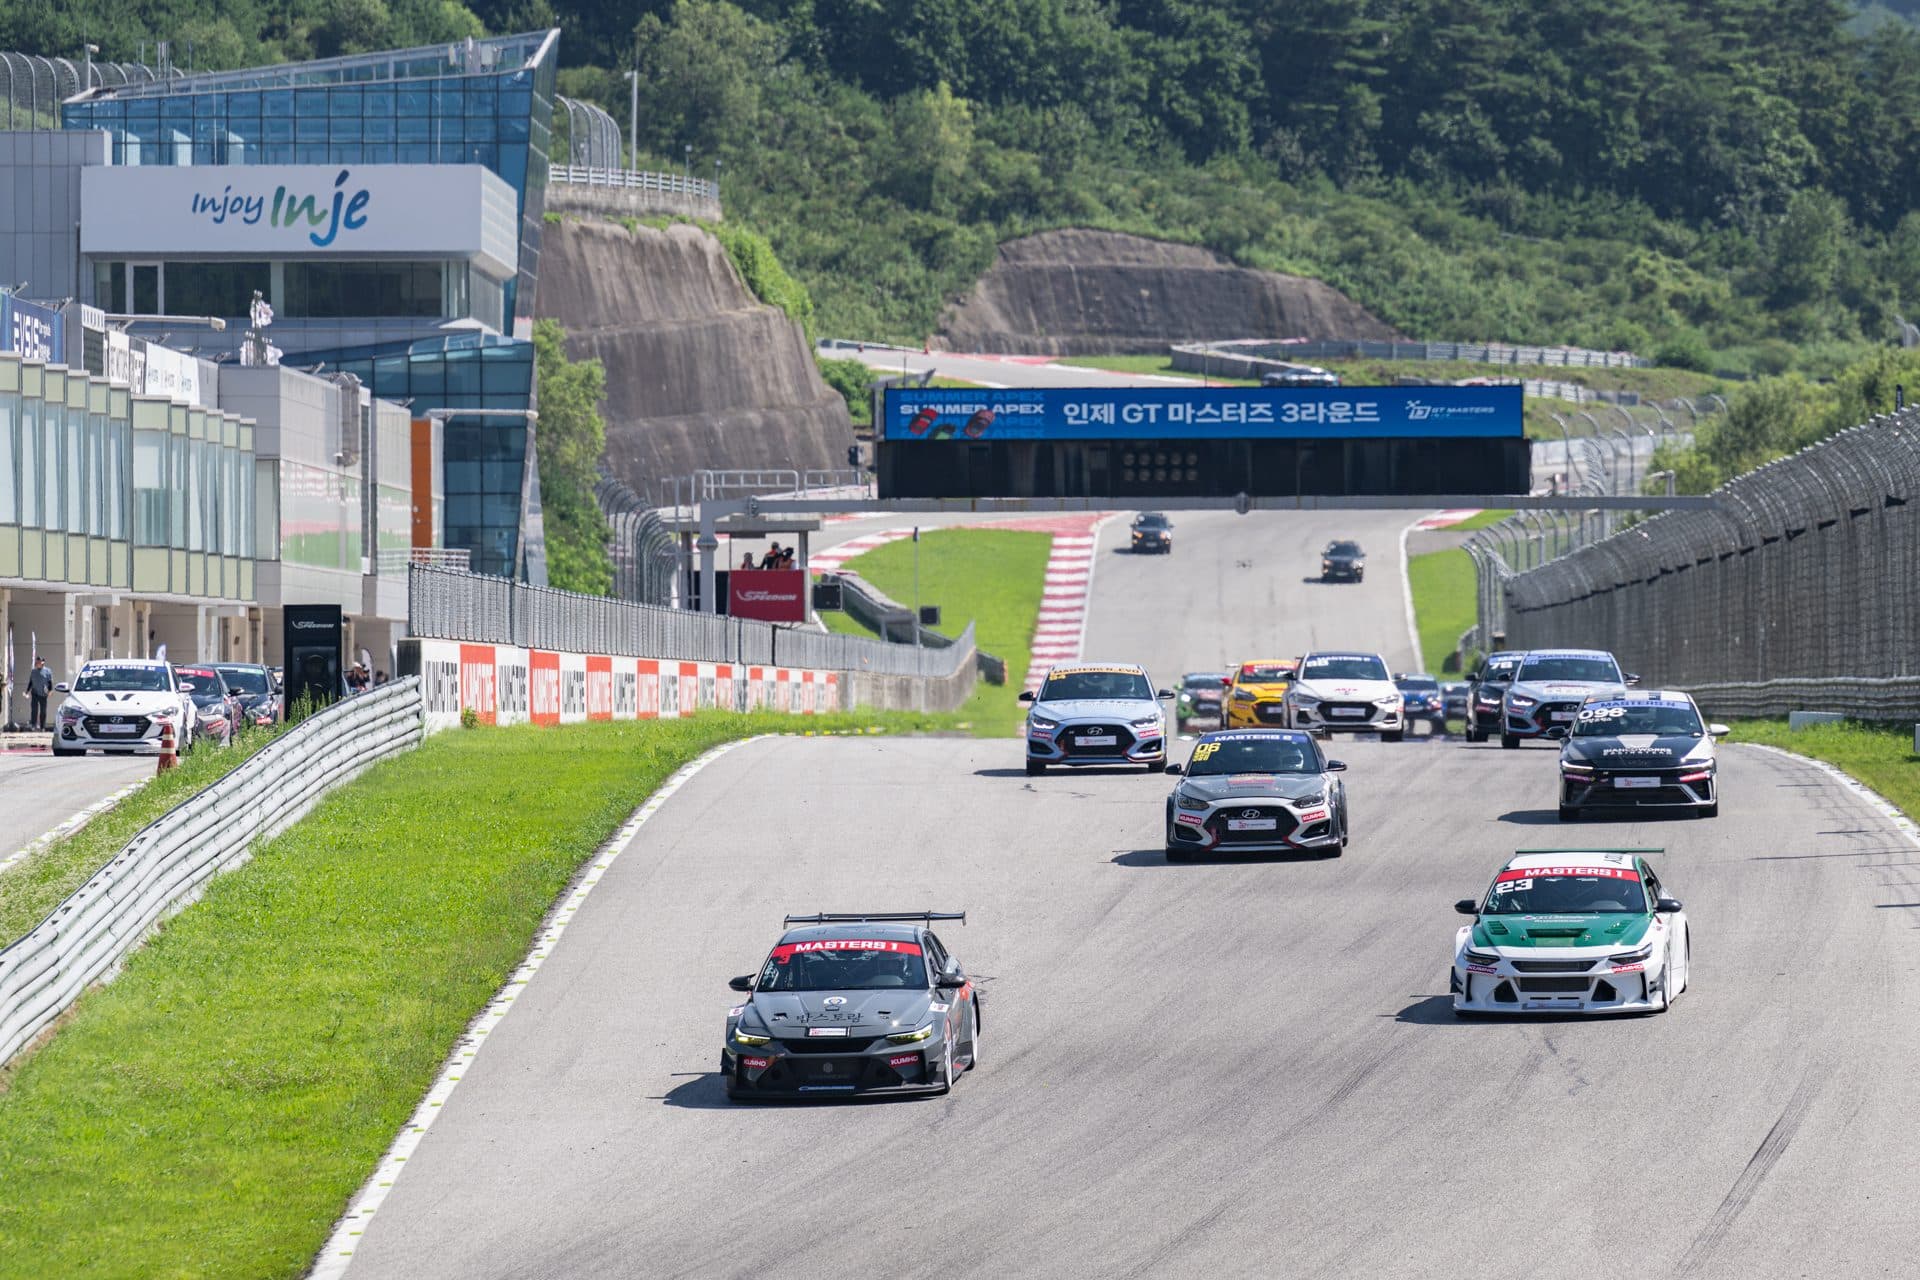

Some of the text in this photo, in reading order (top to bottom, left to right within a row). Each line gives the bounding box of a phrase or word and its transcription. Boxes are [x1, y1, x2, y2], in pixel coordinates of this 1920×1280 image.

[192, 169, 370, 247] Injoy Inje
[991, 404, 1045, 414] APEX
[1063, 402, 1380, 425] 인제 GT 마스터즈 3라운드
[1601, 700, 1663, 708] MASTERS
[1578, 707, 1624, 720] 098
[1214, 734, 1280, 742] MASTERS
[1196, 742, 1221, 753] 06
[1525, 867, 1623, 877] MASTERS 1
[1495, 878, 1534, 894] 23
[795, 940, 898, 952] MASTERS 1
[1468, 965, 1498, 974] KUMHO
[1611, 964, 1645, 973] KUMHO
[743, 1058, 767, 1068] KUMHO
[889, 1055, 919, 1066] KUMHO
